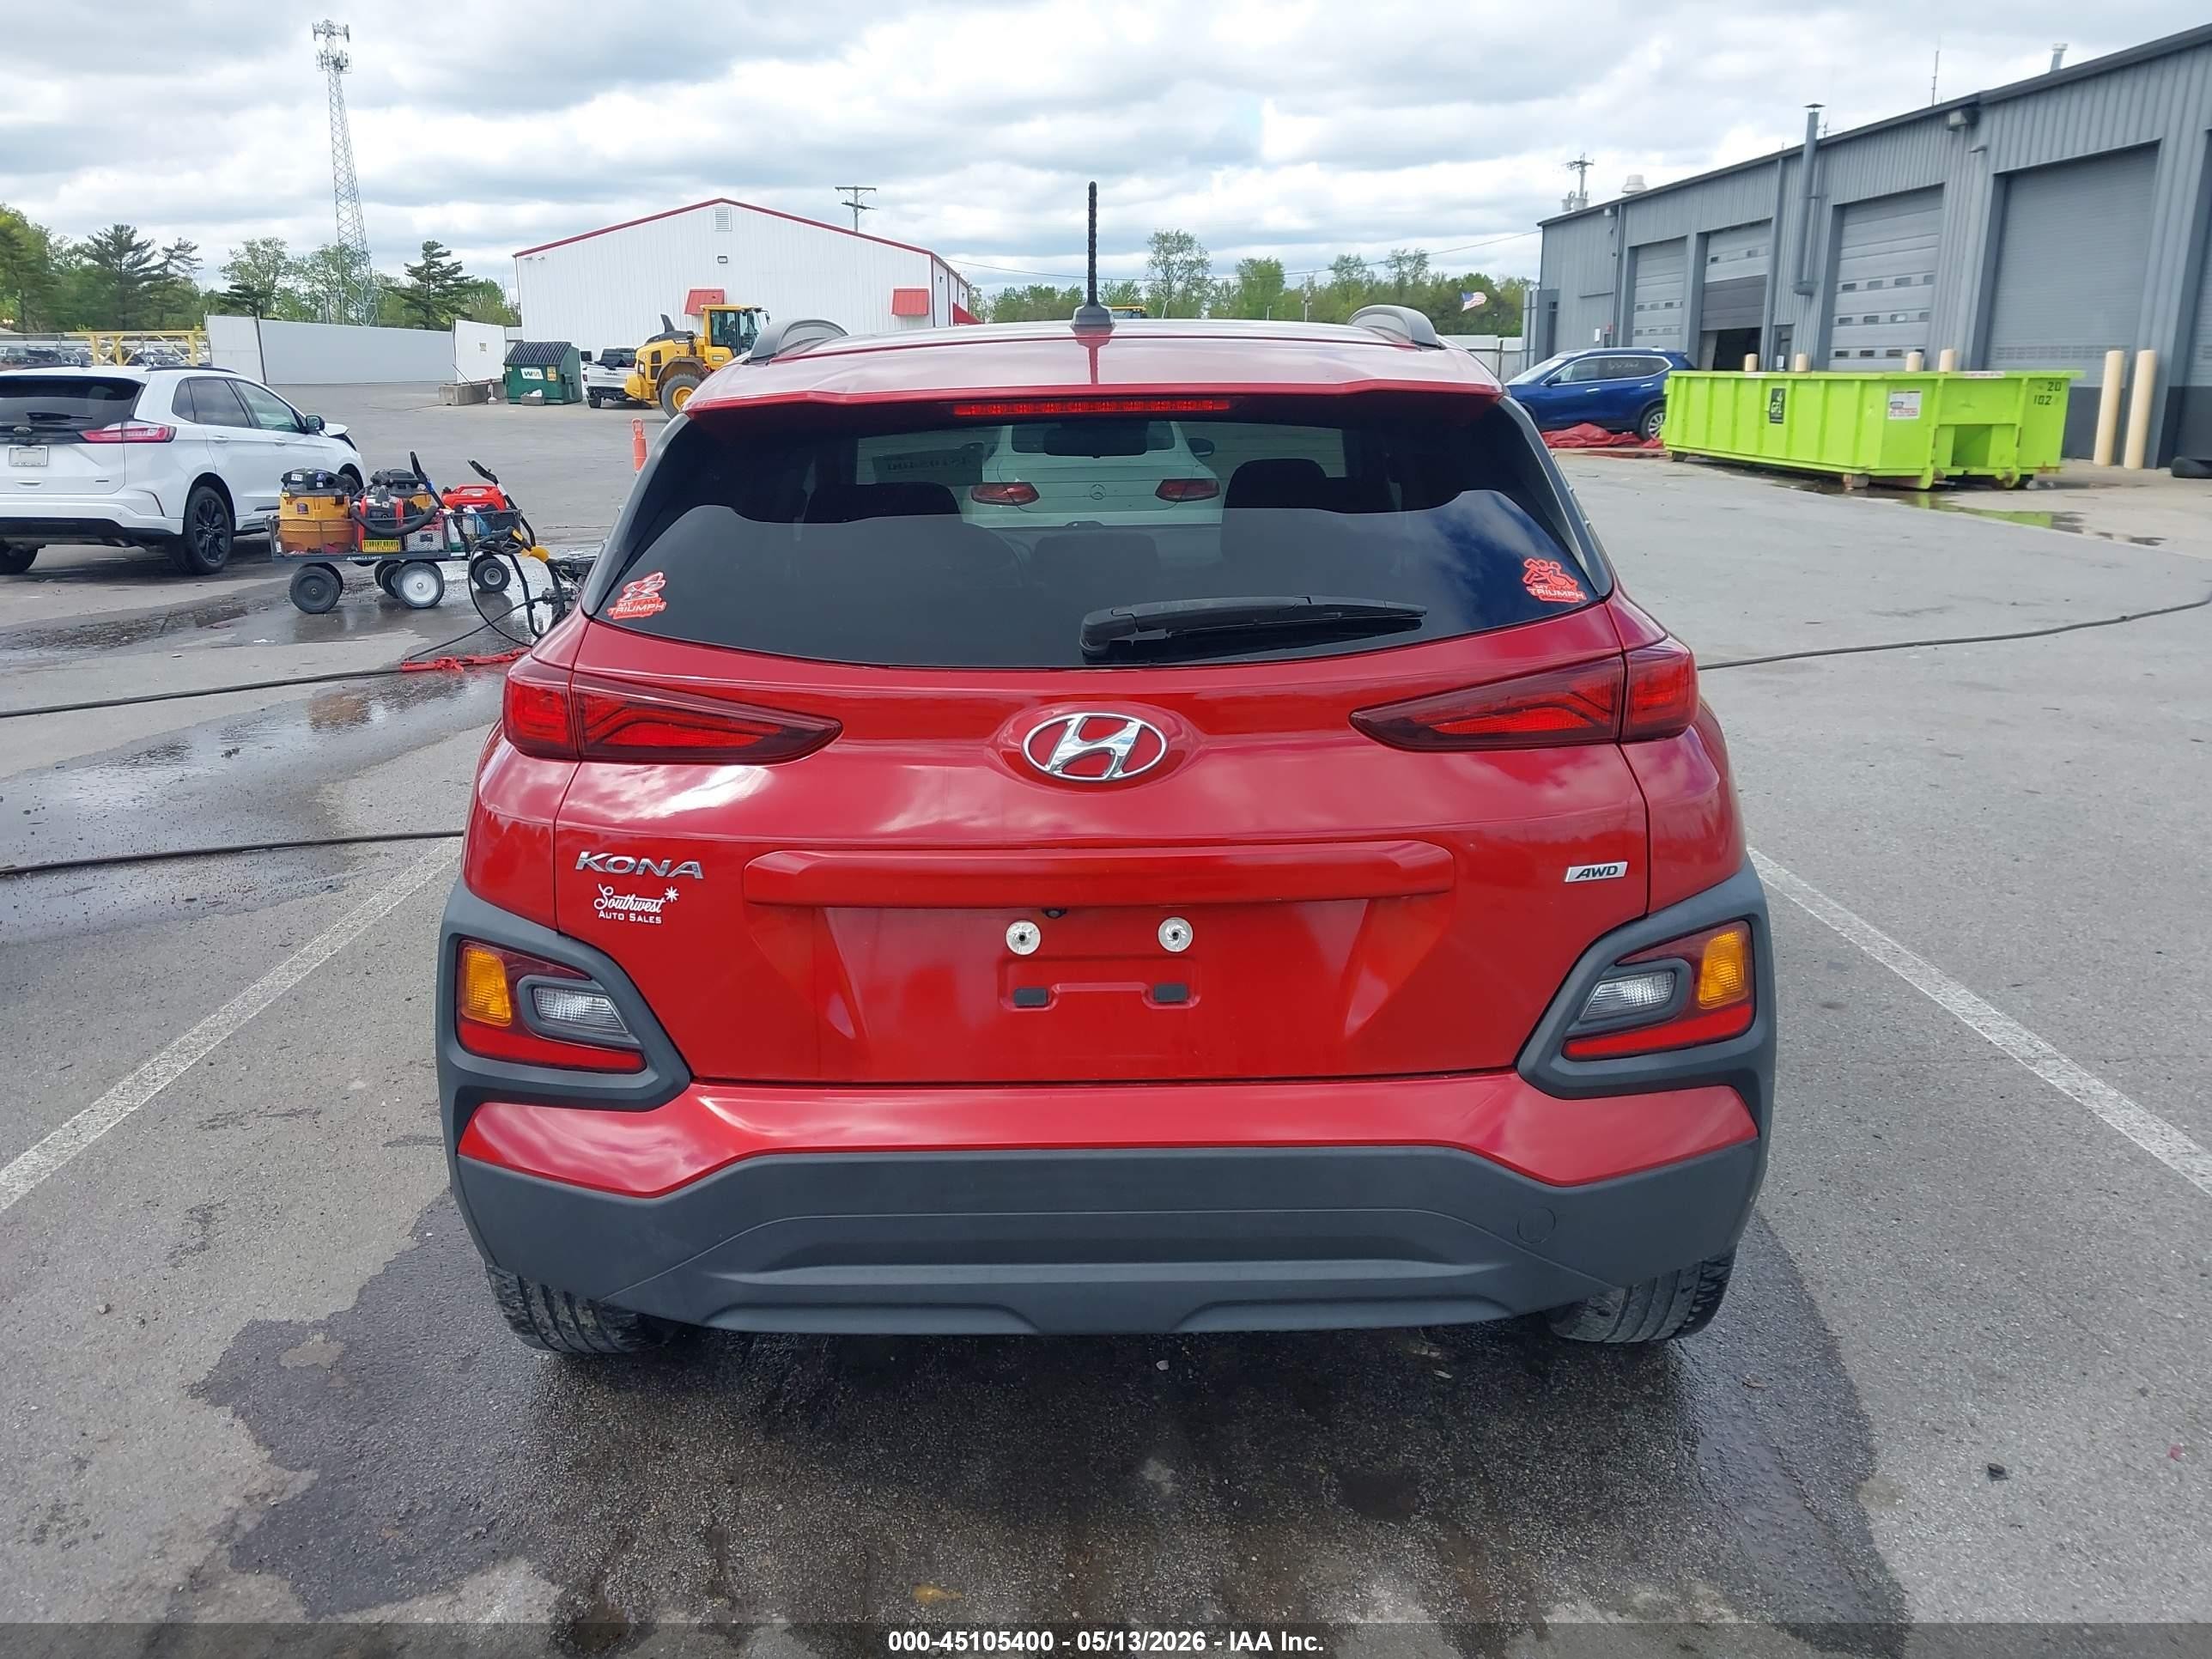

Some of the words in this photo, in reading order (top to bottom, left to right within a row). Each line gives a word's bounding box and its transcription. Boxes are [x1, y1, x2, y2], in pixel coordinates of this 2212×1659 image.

[2047, 381, 2062, 392] 20
[1528, 587, 1585, 600] TRIUMPH
[608, 603, 665, 615] TRIUMPH
[575, 851, 704, 880] KONA
[1575, 865, 1619, 879] AWD
[593, 883, 665, 914] Southwest
